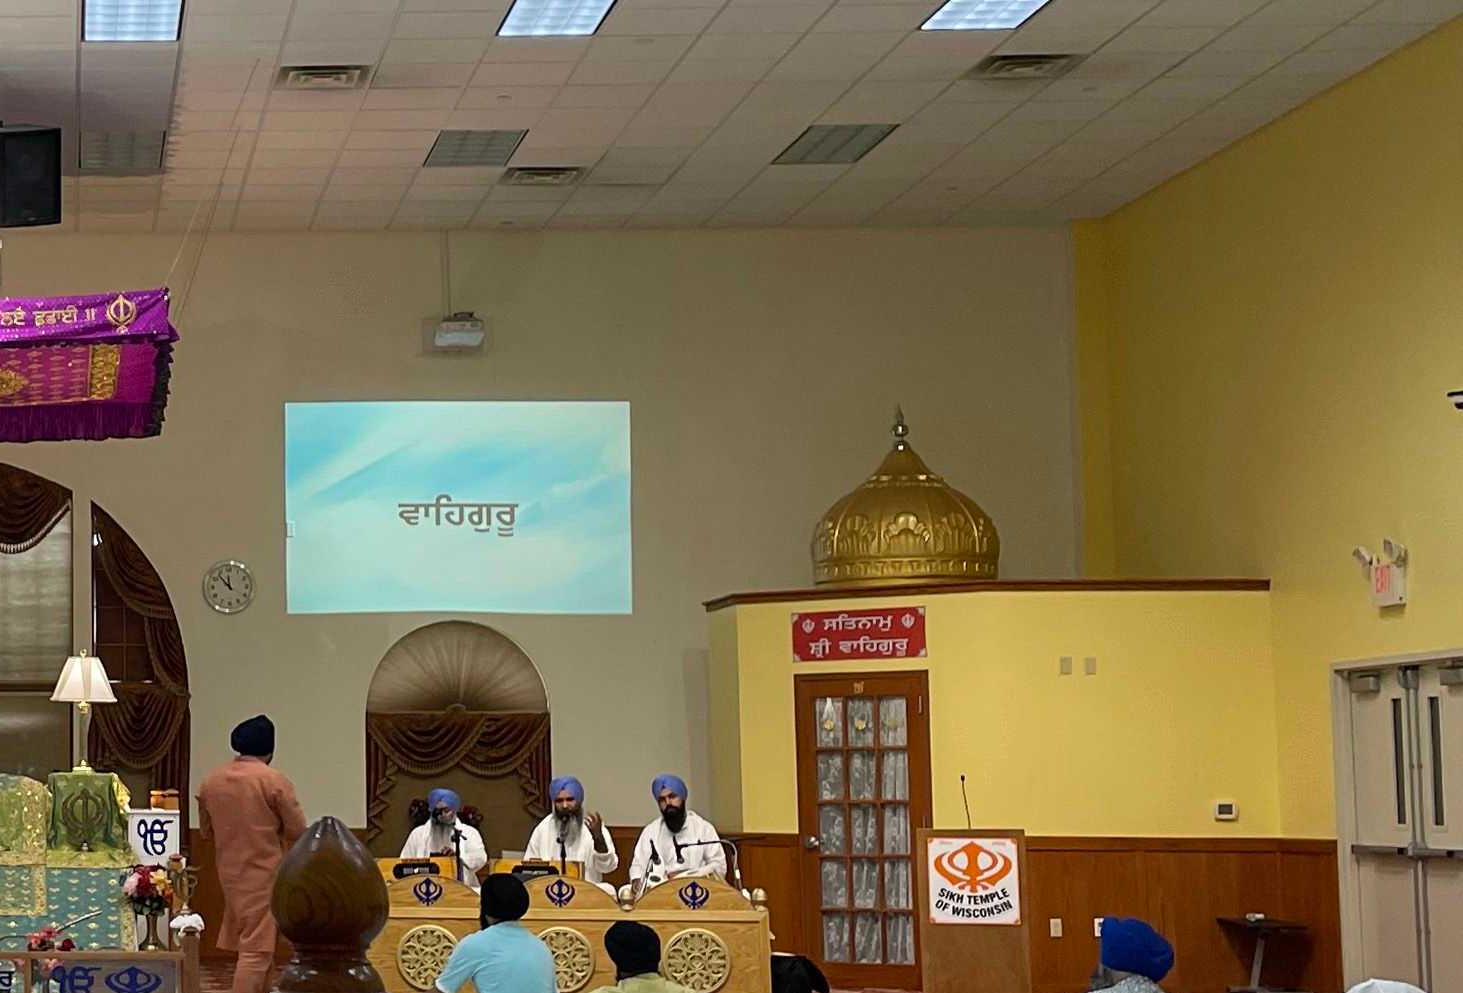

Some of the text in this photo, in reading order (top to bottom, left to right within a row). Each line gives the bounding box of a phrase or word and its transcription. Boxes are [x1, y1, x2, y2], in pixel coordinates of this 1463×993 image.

[398, 494, 519, 537] ਵਾਹਿਗੁਰੂ
[823, 613, 893, 632] ਸਤਿਨਾਮੁ
[839, 635, 909, 657] ਵਾਹਿਗੁਰੂ
[938, 887, 1010, 906] SIKH TEMPLE
[935, 899, 1013, 918] OF WISCONSIN
